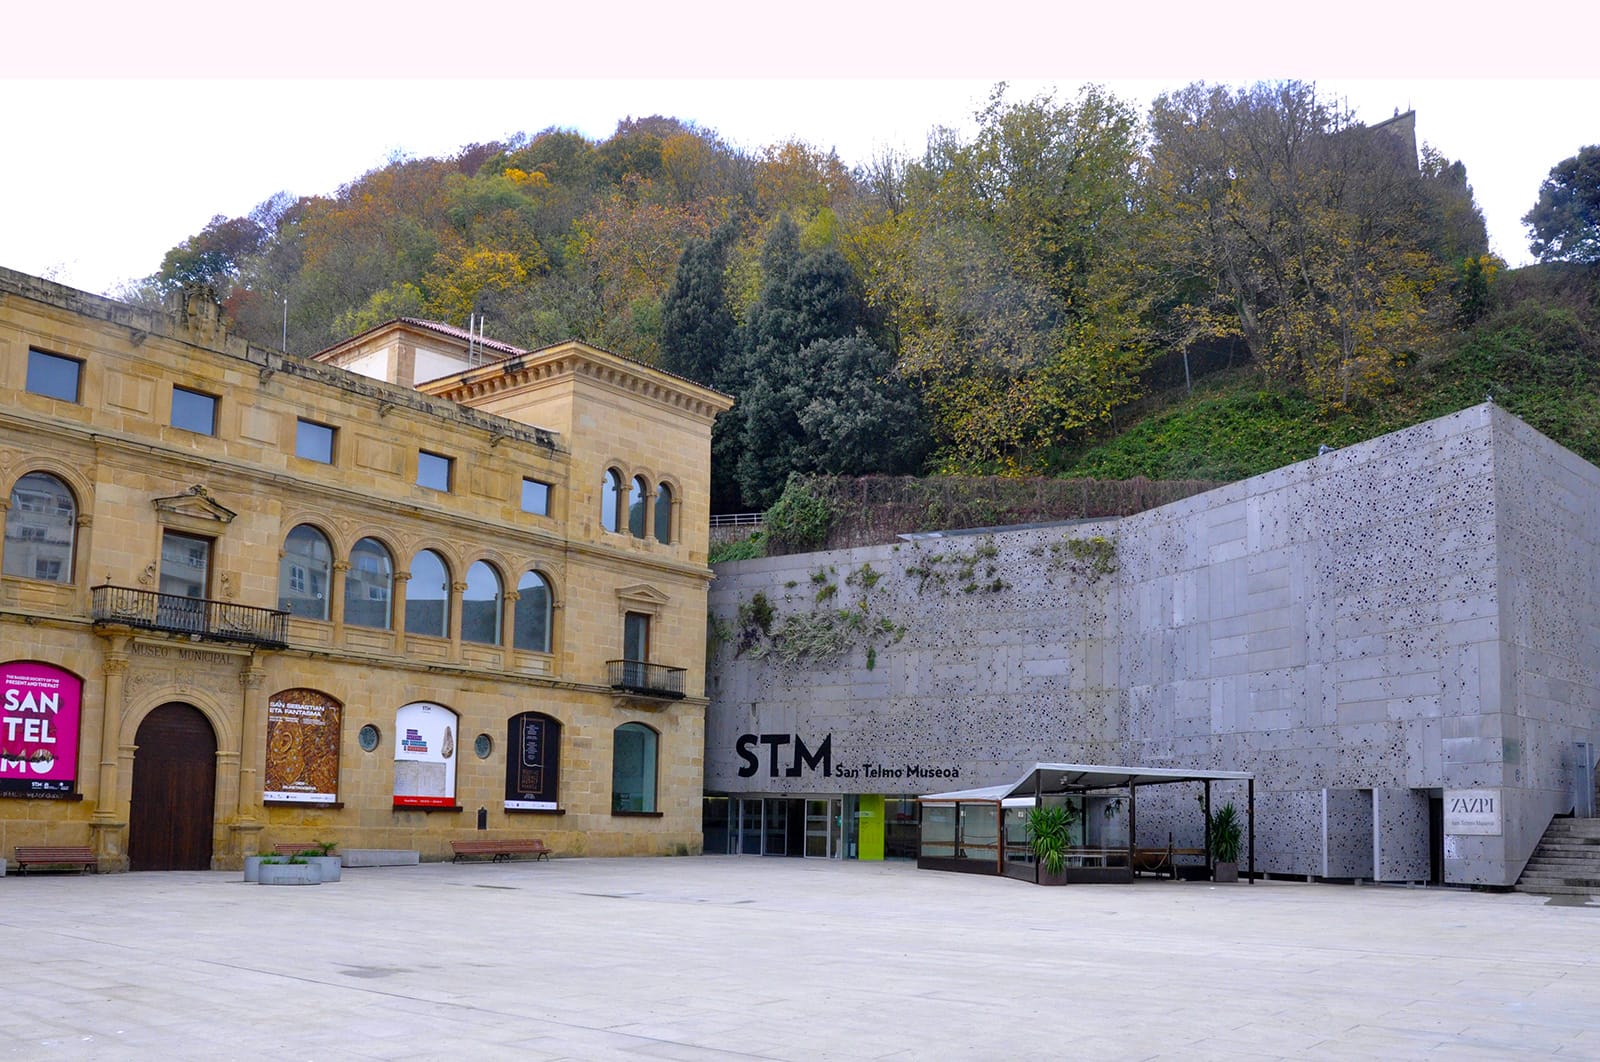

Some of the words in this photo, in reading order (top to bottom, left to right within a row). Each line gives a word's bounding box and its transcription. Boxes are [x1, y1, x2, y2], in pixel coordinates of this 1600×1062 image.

[131, 642, 169, 657] MUSEO
[178, 648, 233, 665] MUNICIPAL
[4, 689, 59, 714] SAN
[269, 700, 285, 708] SAN
[287, 703, 325, 711] SEBASTIAN
[285, 709, 321, 717] FANTASMA
[3, 717, 56, 744] TEL
[0, 746, 55, 774] MO
[736, 733, 832, 778] STM
[835, 764, 859, 779] San
[862, 764, 902, 778] Telmo
[907, 764, 960, 778] Museoa
[1451, 798, 1494, 813] ZAZPI
